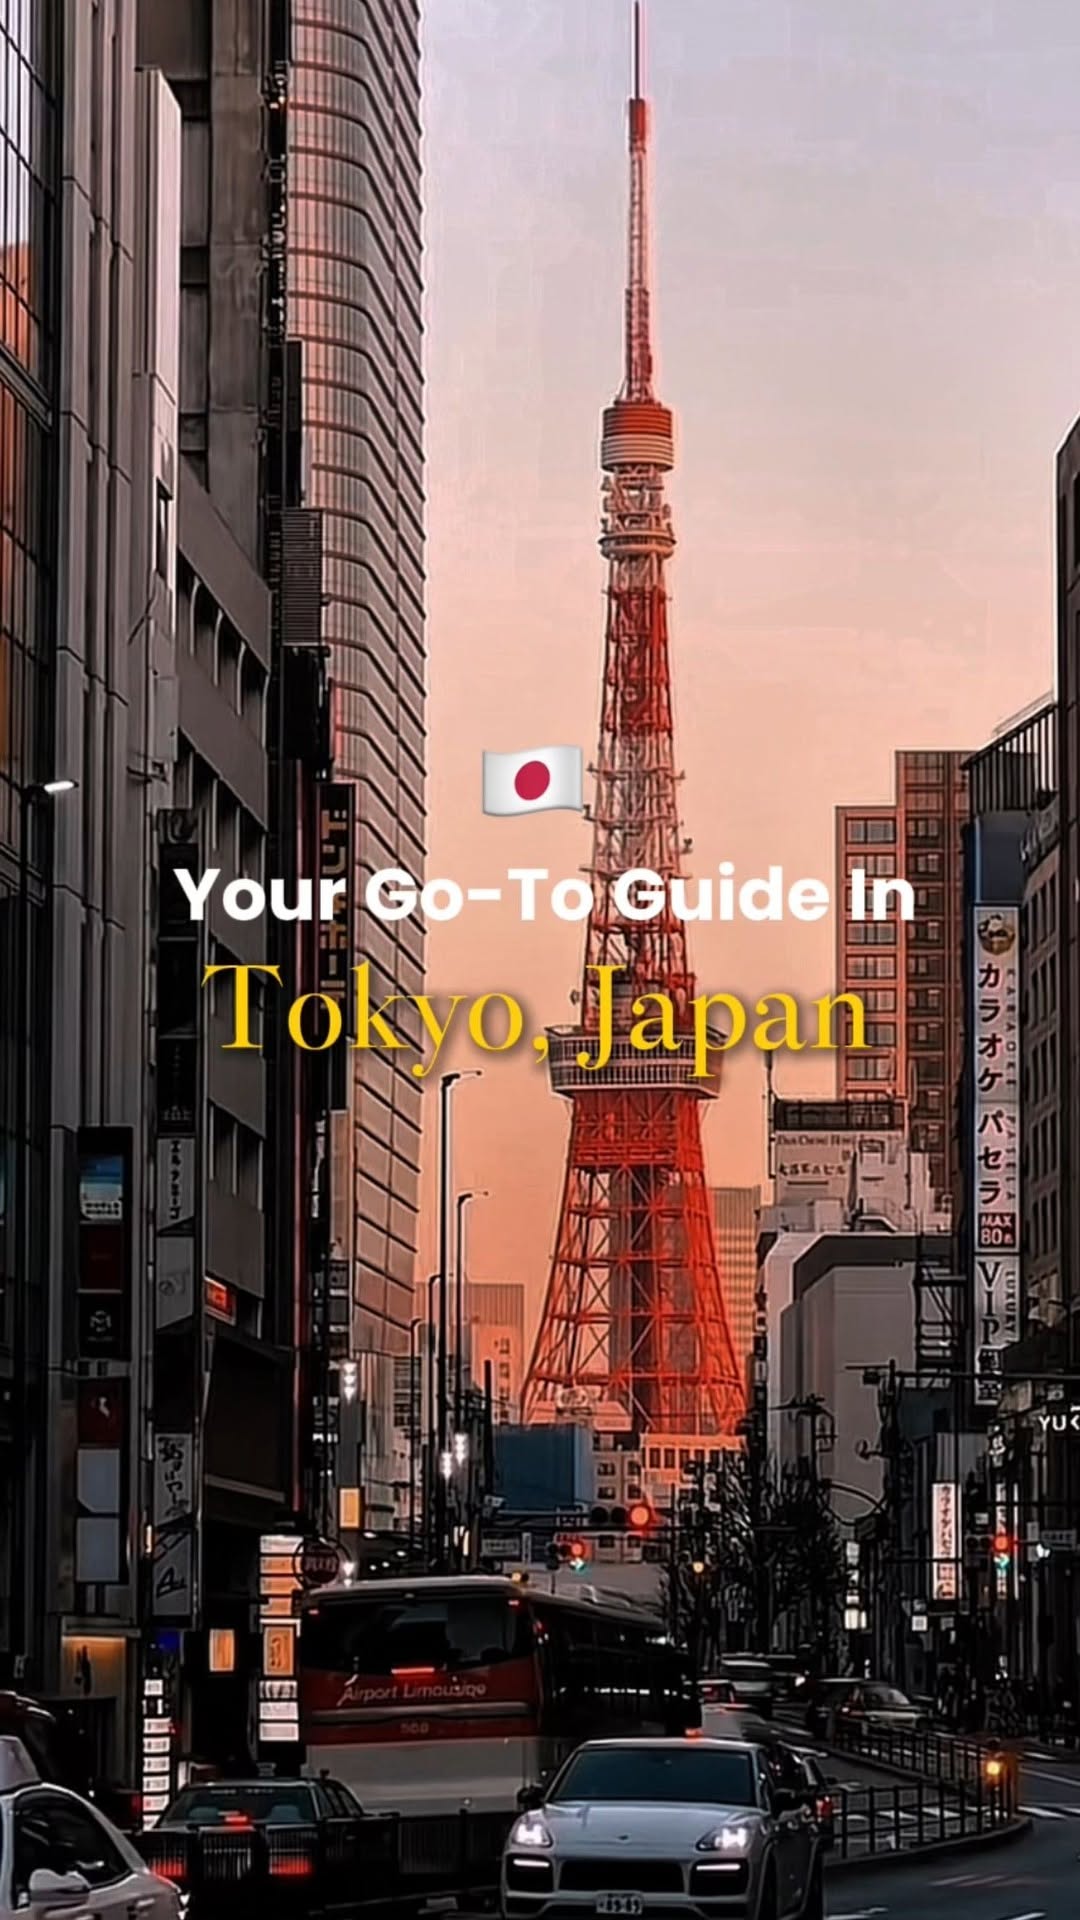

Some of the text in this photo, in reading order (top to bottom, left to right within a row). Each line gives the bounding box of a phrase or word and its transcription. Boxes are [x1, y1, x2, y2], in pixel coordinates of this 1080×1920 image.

[977, 962, 1003, 1093] カラオケ
[977, 1108, 1005, 1205] パセラ
[981, 1215, 1013, 1227] MAX
[336, 1678, 487, 1706] Airport Limousine
